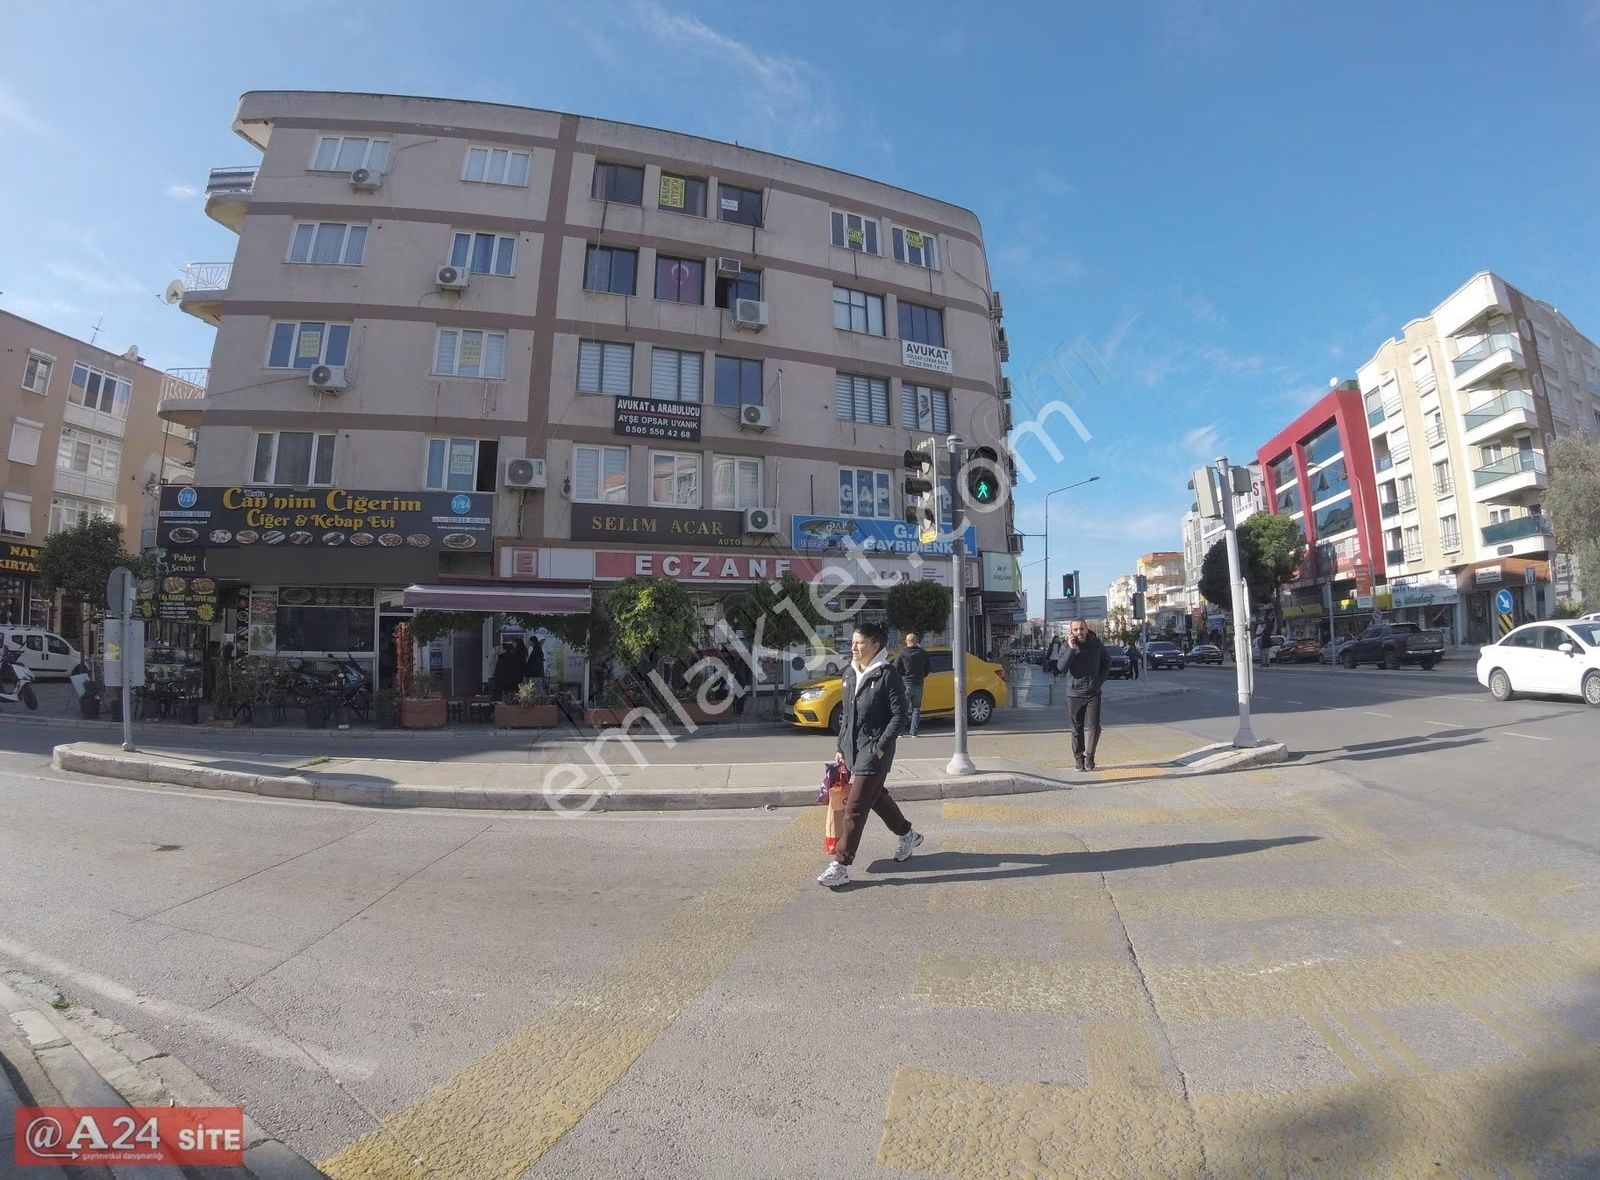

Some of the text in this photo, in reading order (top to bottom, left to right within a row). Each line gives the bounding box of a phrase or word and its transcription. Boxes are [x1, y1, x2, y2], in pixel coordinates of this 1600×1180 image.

[906, 343, 949, 360] AVUKAT
[617, 400, 700, 417] AVUKAT & ARABULUCU
[618, 414, 698, 429] AYŞE OPSAR UYANIK
[625, 426, 647, 434] 0505
[649, 427, 665, 435] 550
[326, 489, 422, 514] Ciğerim
[247, 508, 395, 531] Ciğer & Kebap Evi
[592, 514, 724, 535] SELİM ACAR
[718, 538, 741, 546] AUTO
[864, 540, 972, 554] GAYRİMENKL
